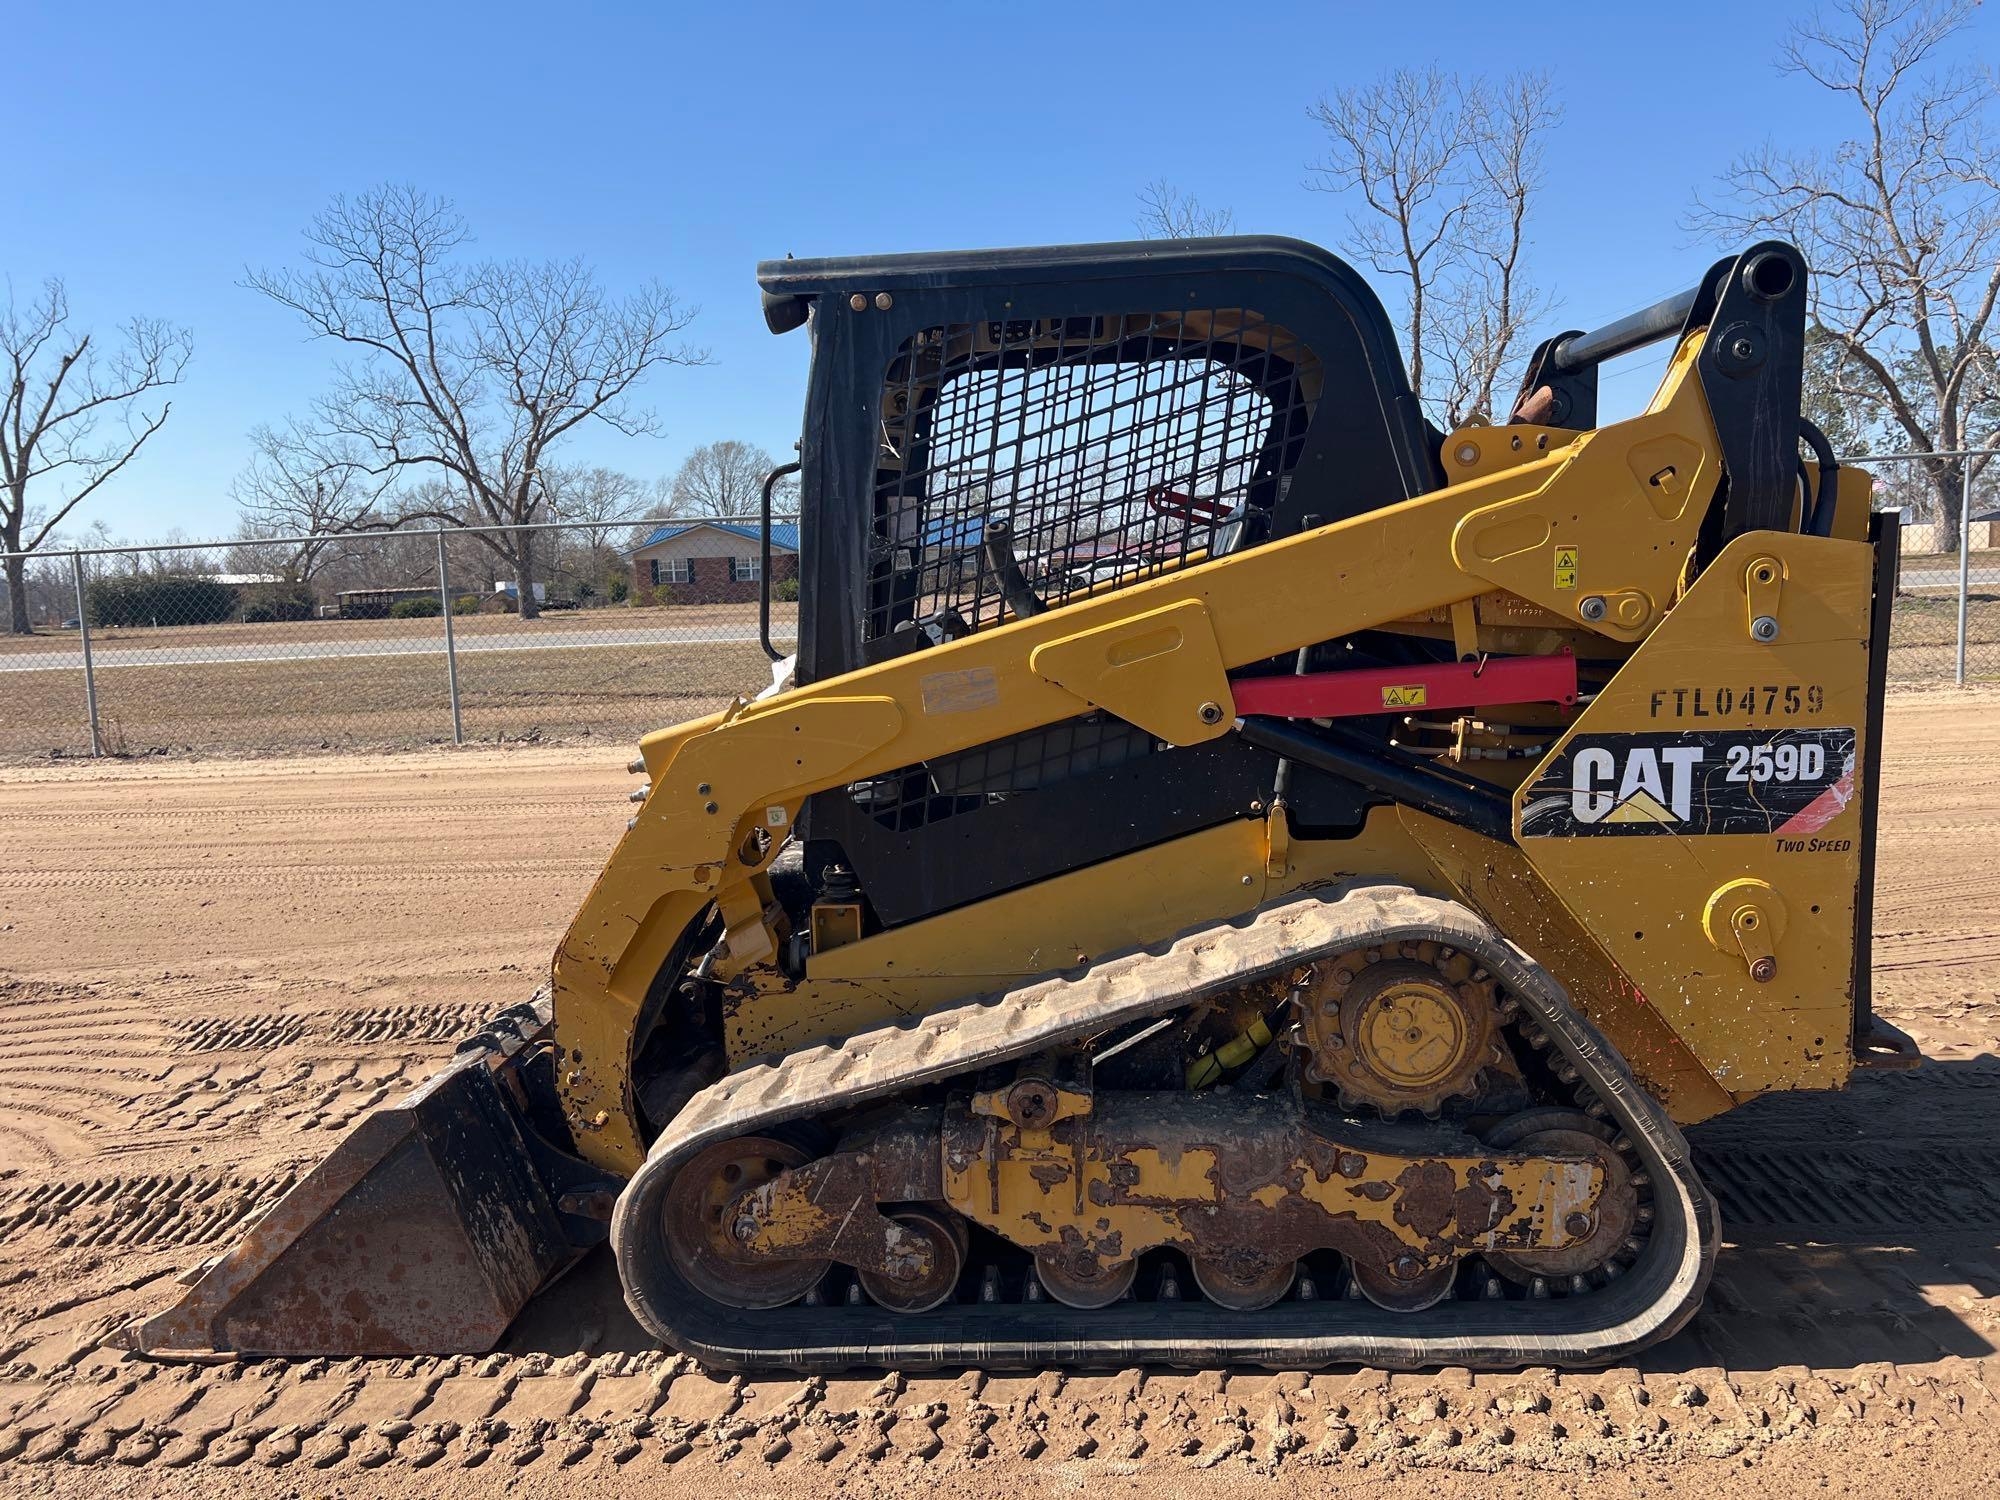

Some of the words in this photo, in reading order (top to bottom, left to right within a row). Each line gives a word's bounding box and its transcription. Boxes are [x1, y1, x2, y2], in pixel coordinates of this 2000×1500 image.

[1650, 685, 1824, 717] FTL04759
[1572, 747, 1704, 824] CAT
[1726, 743, 1825, 782] 259D
